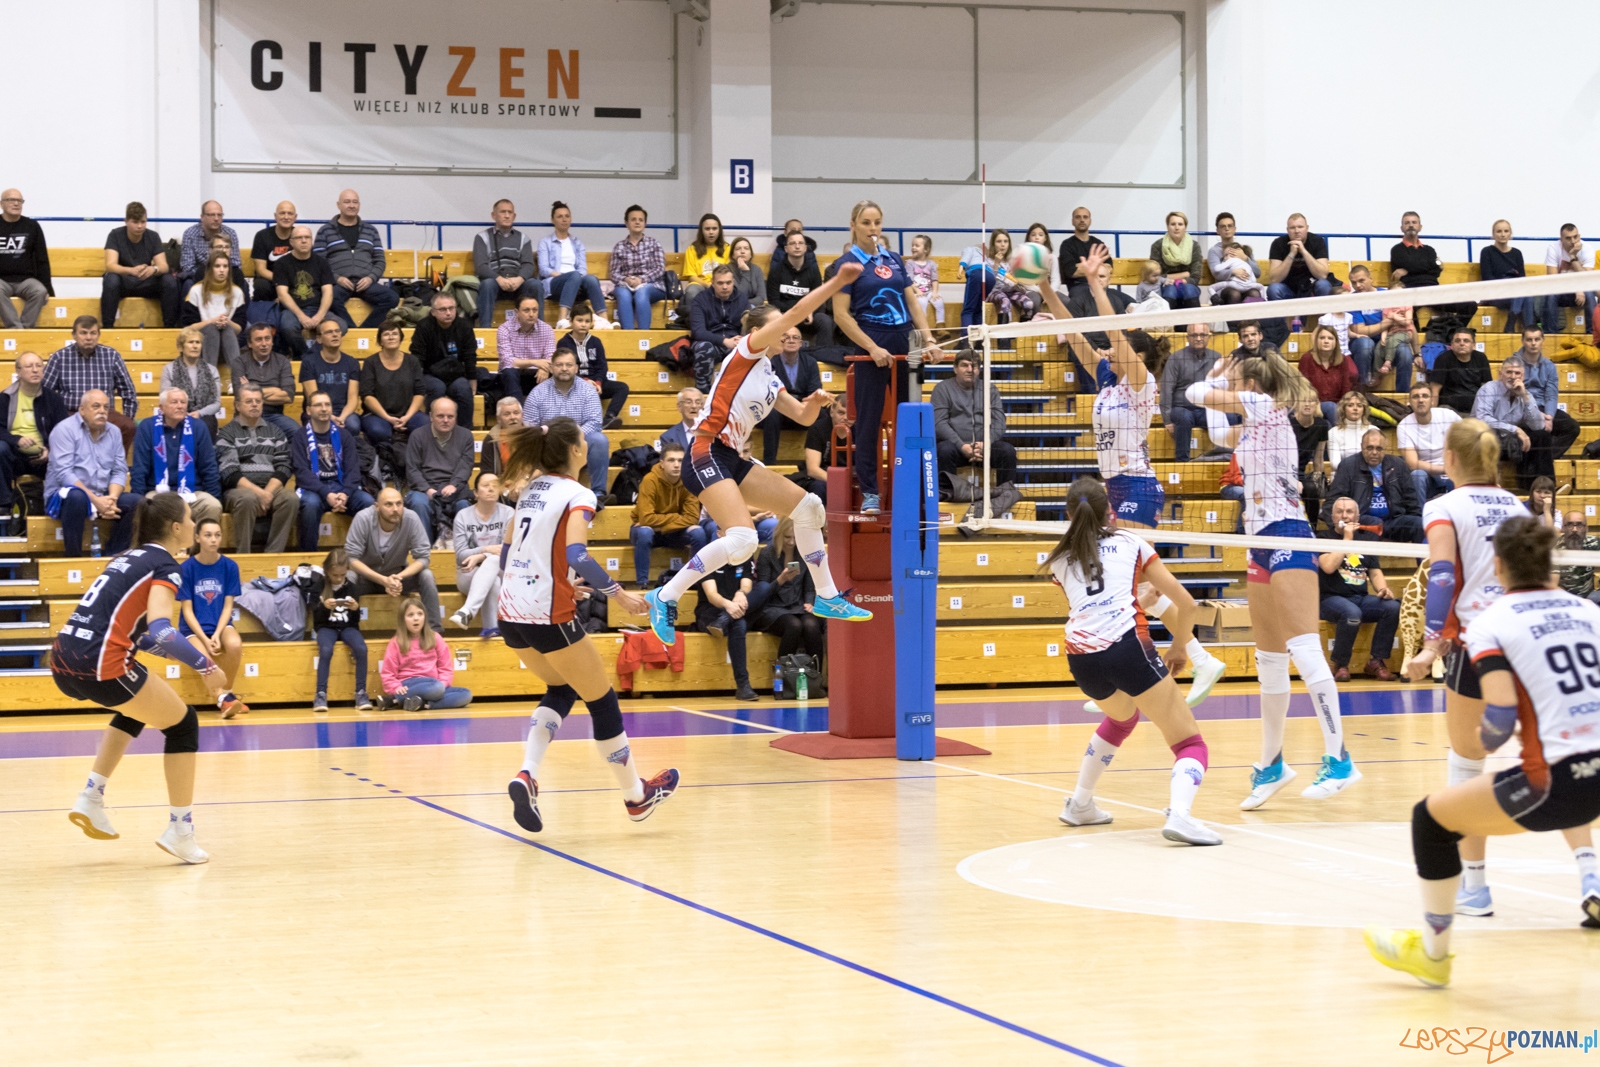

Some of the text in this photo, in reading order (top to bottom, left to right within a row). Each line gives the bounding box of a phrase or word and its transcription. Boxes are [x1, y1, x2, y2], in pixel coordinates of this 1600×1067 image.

[251, 39, 579, 99] CITYZEN
[353, 99, 581, 117] WIĘCEJ NIŻ KLUB SPORTOWY
[734, 164, 749, 188] B
[785, 285, 805, 295] VOLTS
[700, 466, 716, 478] 19
[925, 462, 934, 498] Senoh
[466, 524, 483, 532] NEW
[518, 517, 530, 552] 7
[79, 574, 109, 608] 8
[864, 594, 894, 602] Senoh
[1545, 642, 1600, 695] 99
